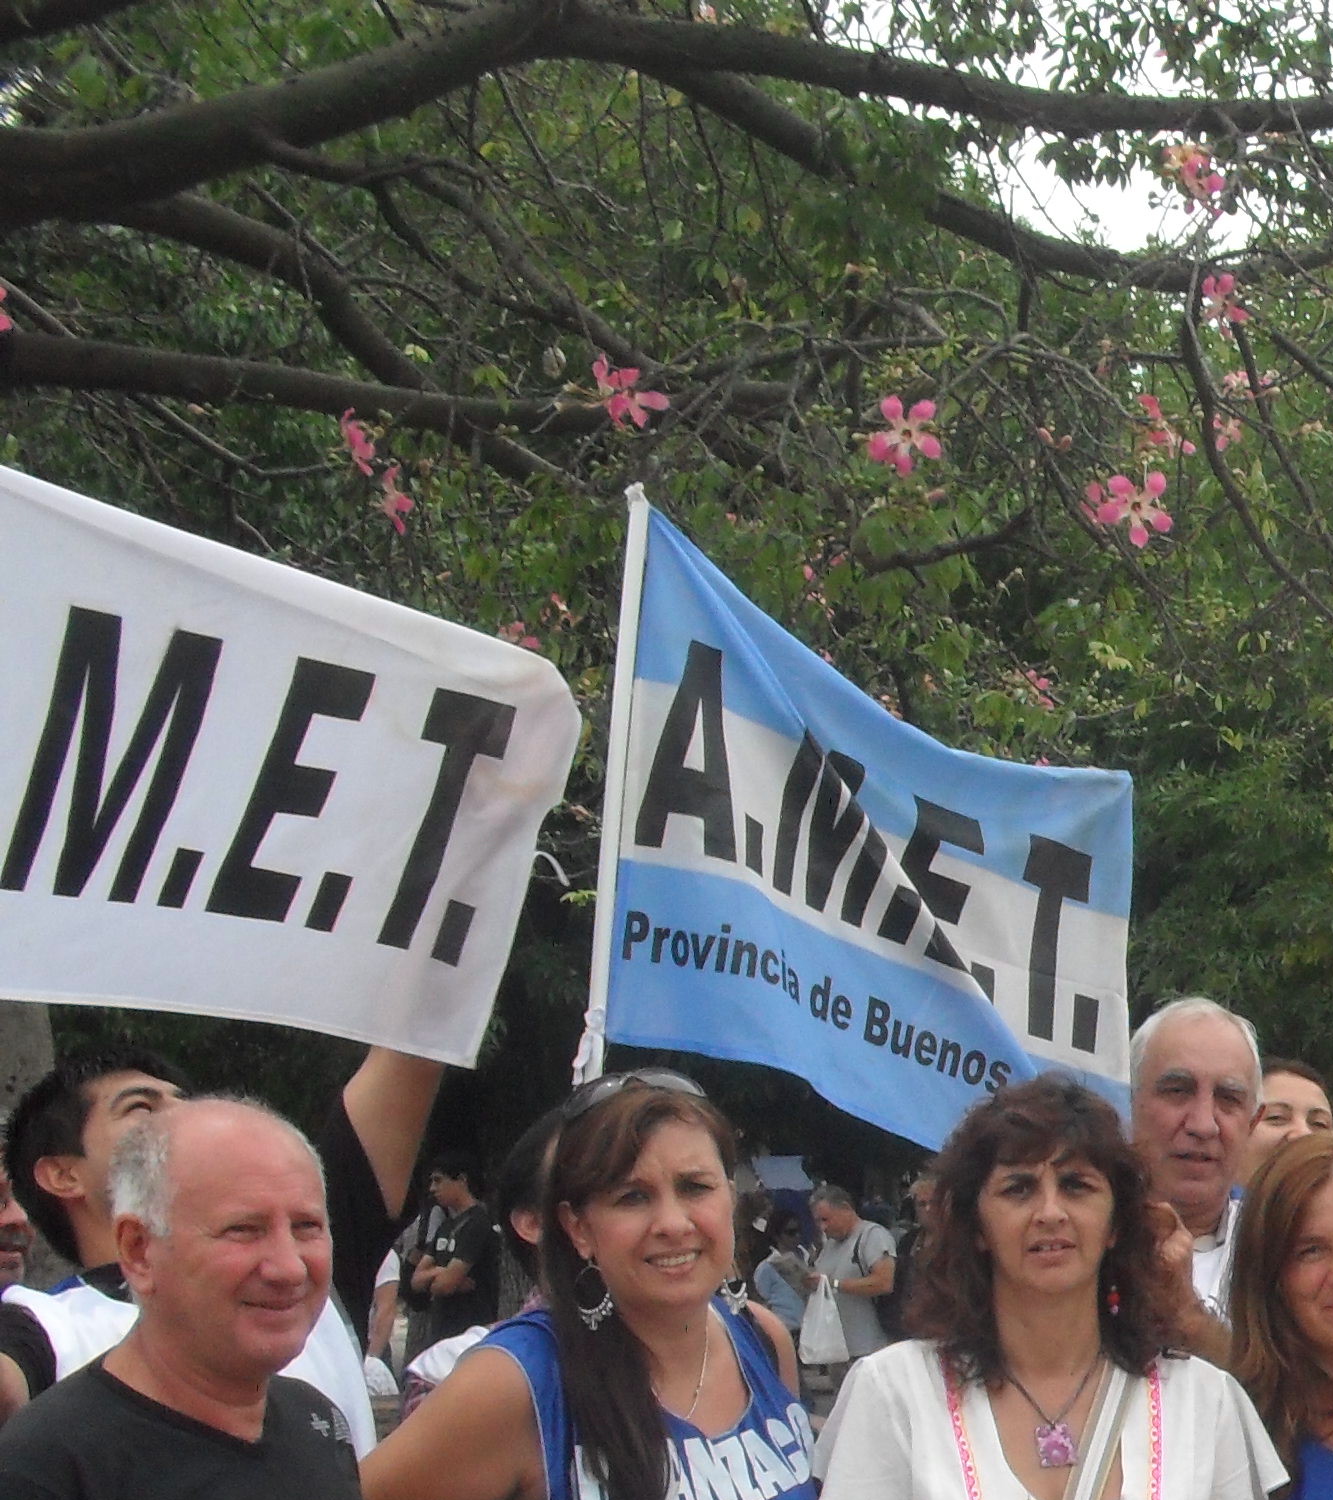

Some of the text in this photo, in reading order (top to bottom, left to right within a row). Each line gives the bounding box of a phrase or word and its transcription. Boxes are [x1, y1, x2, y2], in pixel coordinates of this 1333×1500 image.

[634, 639, 1100, 1054] A.M.E.T.
[621, 910, 1013, 1095] Provincia de Buenos
